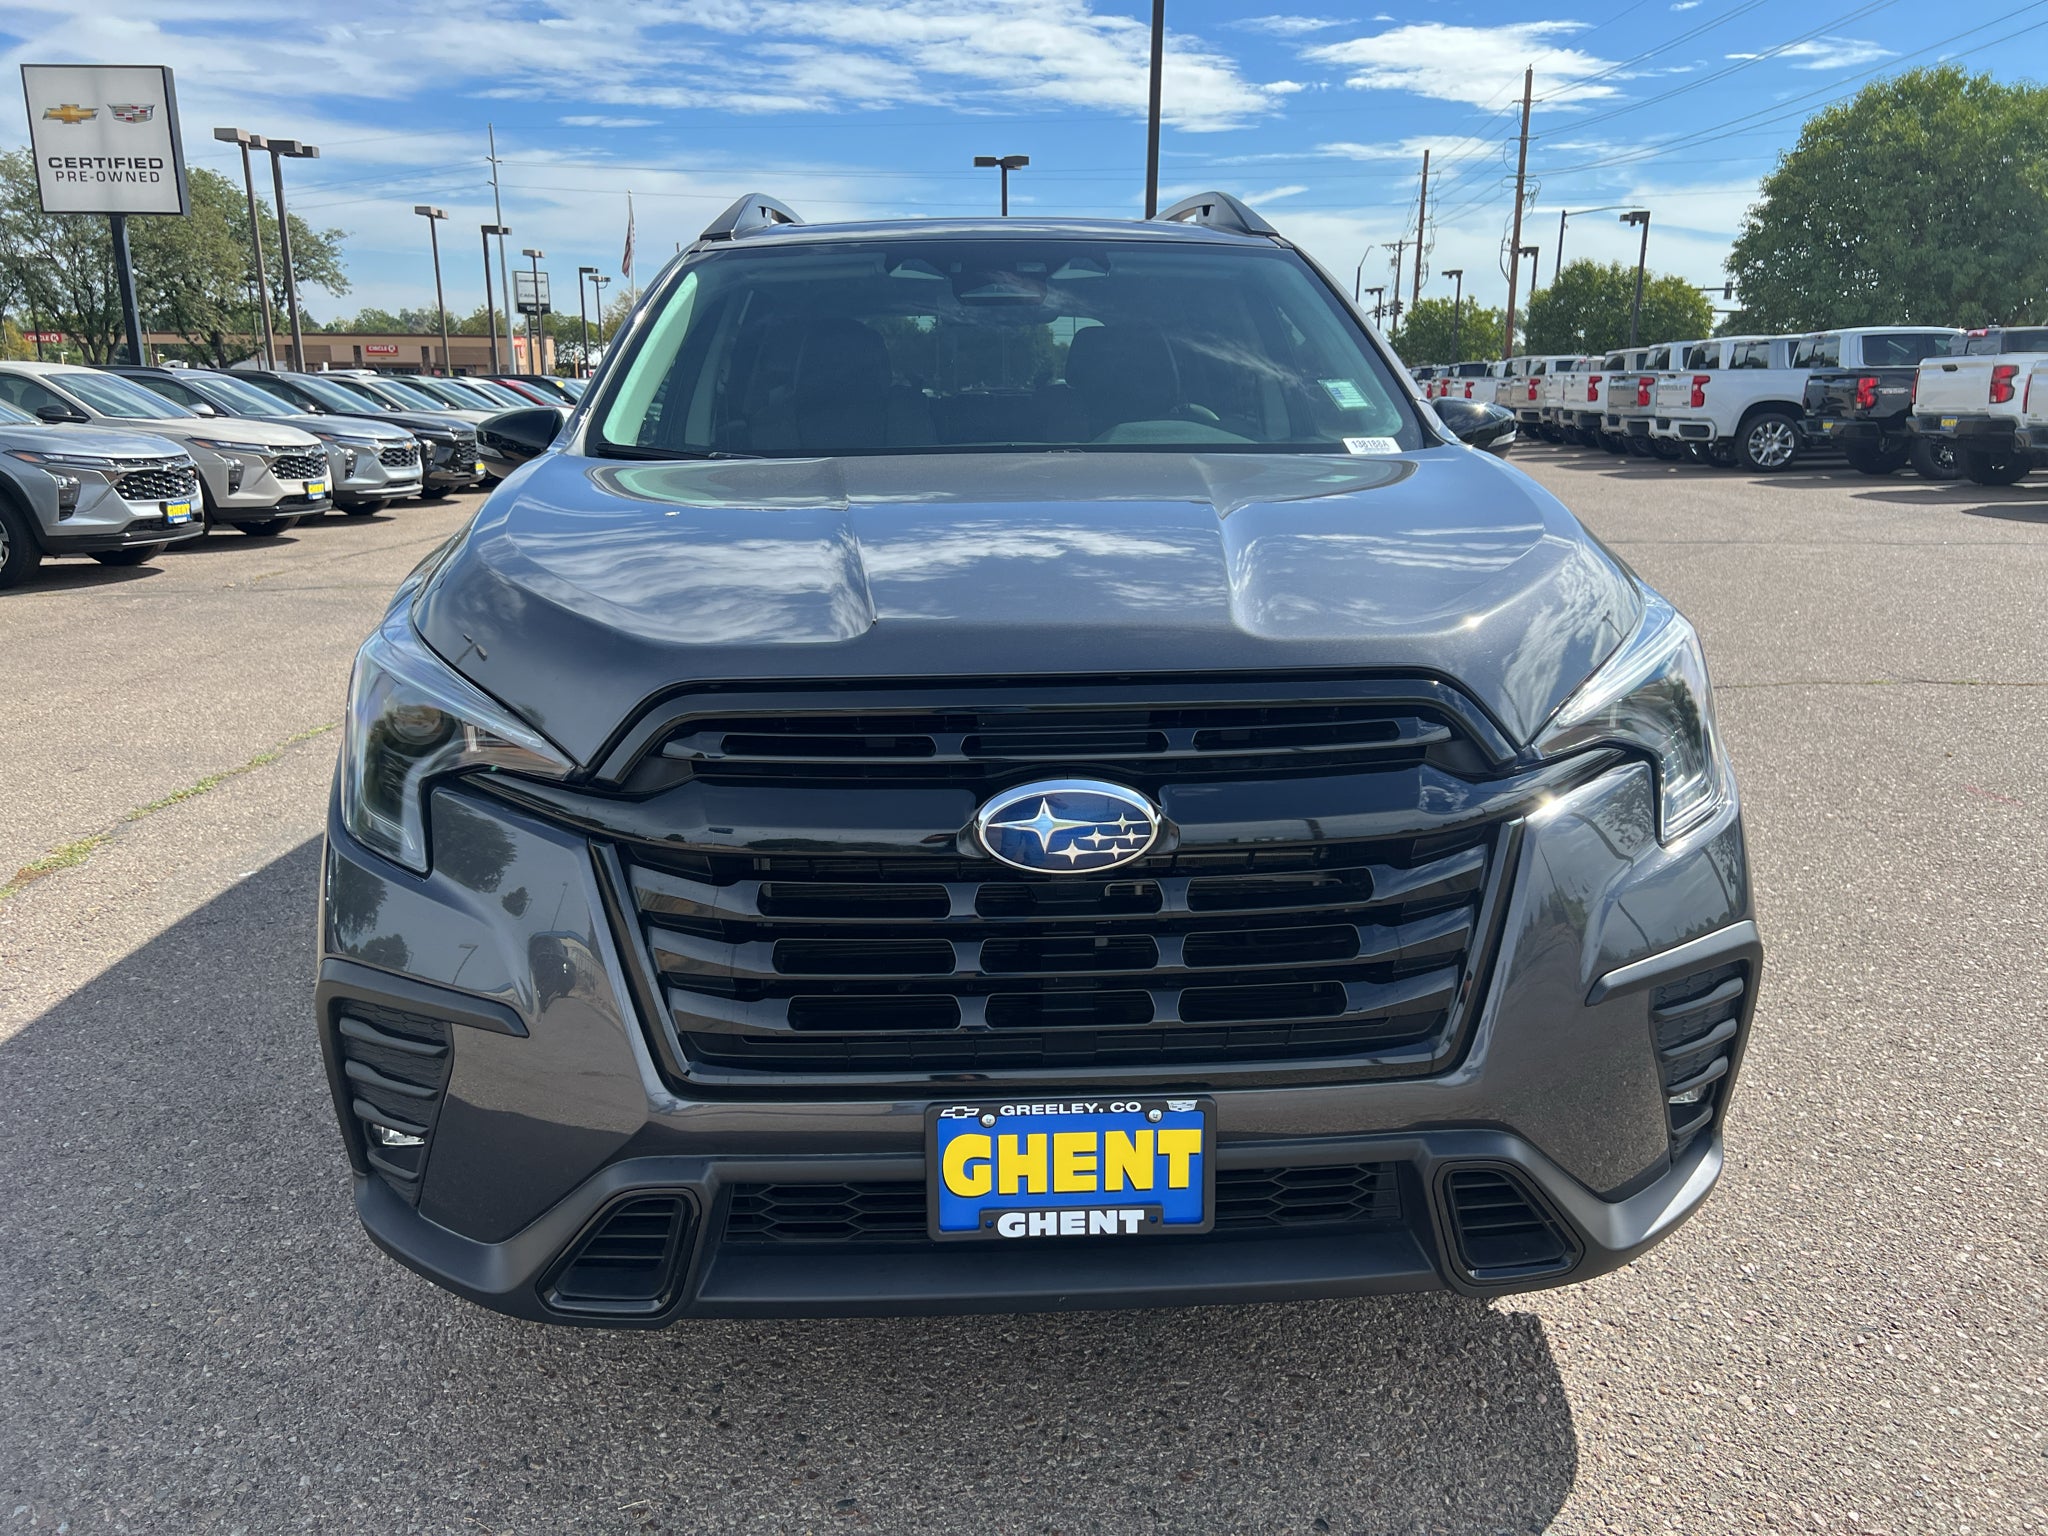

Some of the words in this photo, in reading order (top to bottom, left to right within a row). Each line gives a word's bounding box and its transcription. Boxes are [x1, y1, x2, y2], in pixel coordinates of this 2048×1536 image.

[48, 156, 164, 170] CERTIFIED
[55, 170, 160, 183] PRE-OWNED
[1109, 1101, 1142, 1113] CO
[942, 1129, 1202, 1198] GHENT
[997, 1209, 1145, 1238] GHENT
